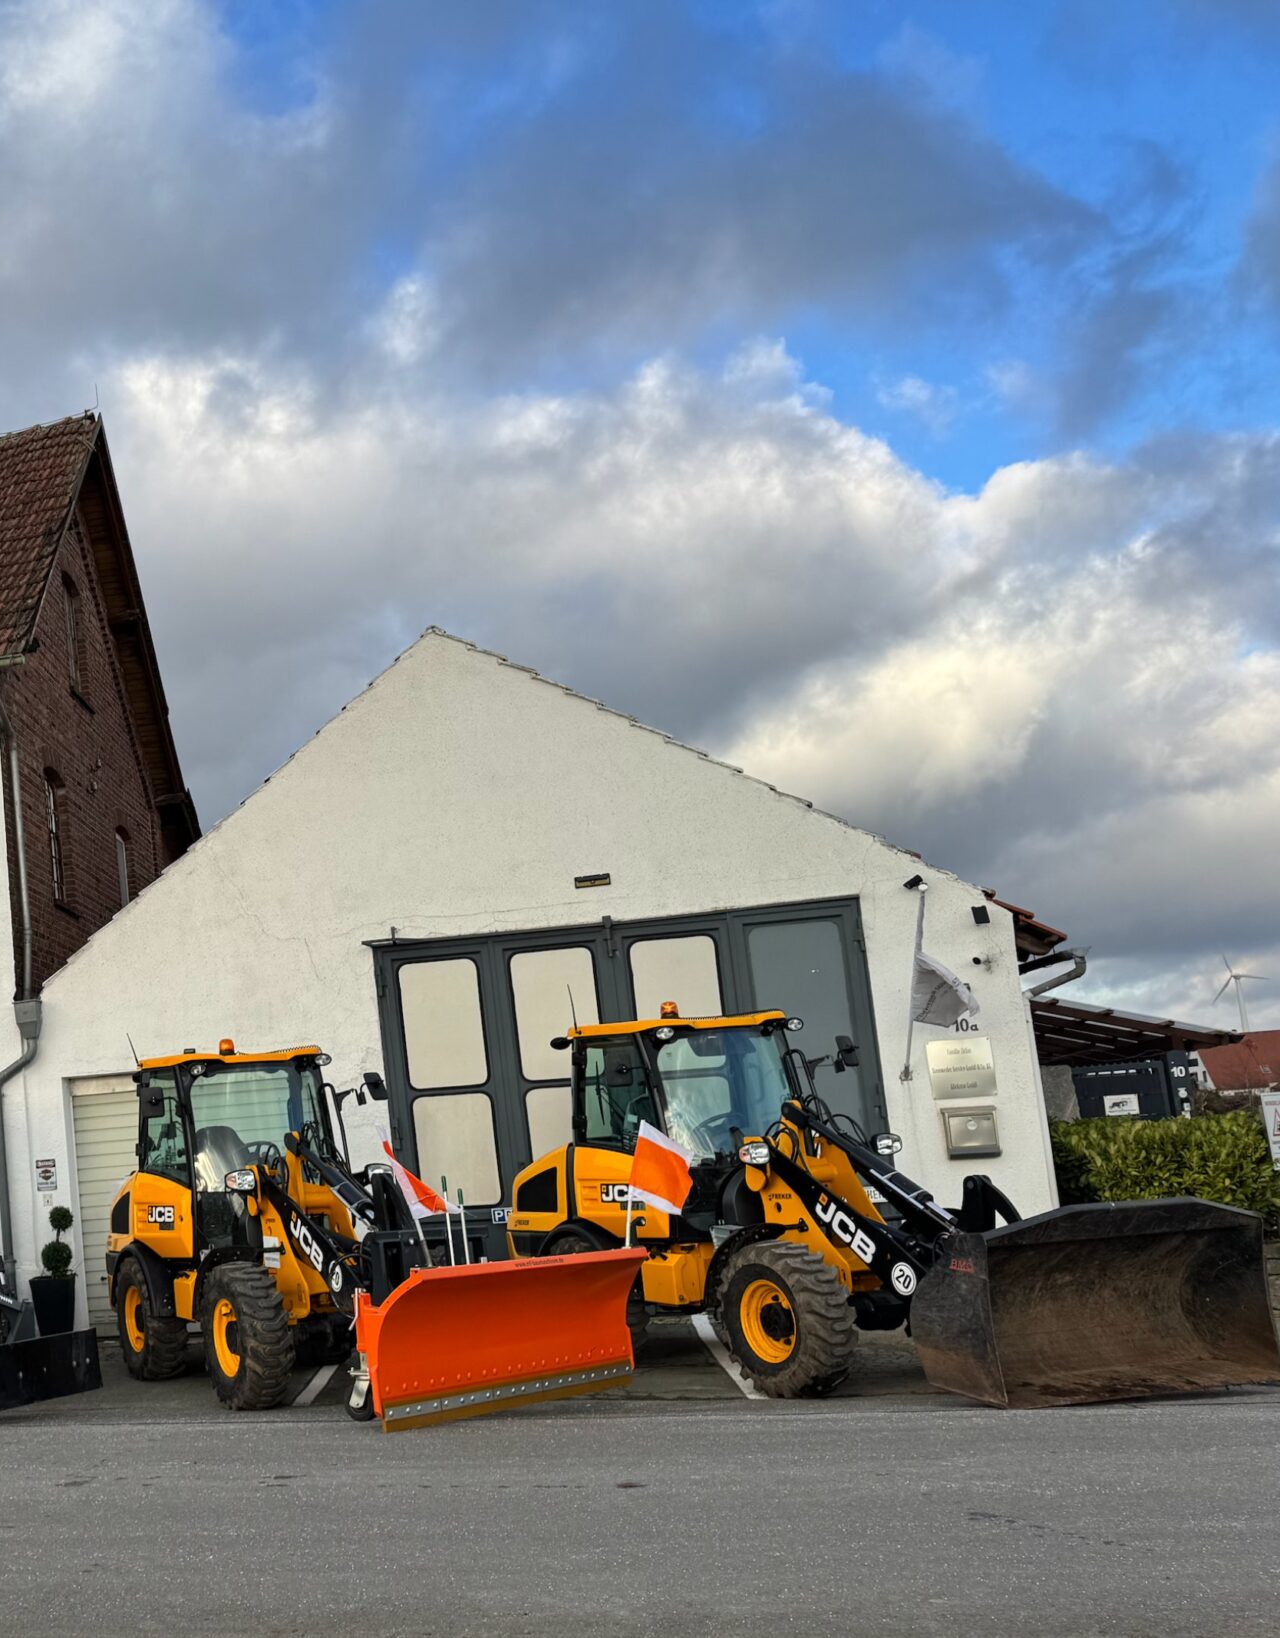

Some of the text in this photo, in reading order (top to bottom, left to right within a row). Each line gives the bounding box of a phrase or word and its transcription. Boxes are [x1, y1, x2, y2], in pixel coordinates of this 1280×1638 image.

[954, 1018, 979, 1032] 10a
[1171, 1066, 1186, 1077] 10
[148, 1206, 174, 1223] JCB
[494, 1210, 504, 1222] P
[815, 1192, 876, 1264] JCB
[290, 1211, 324, 1272] JCB
[895, 1268, 912, 1290] 20
